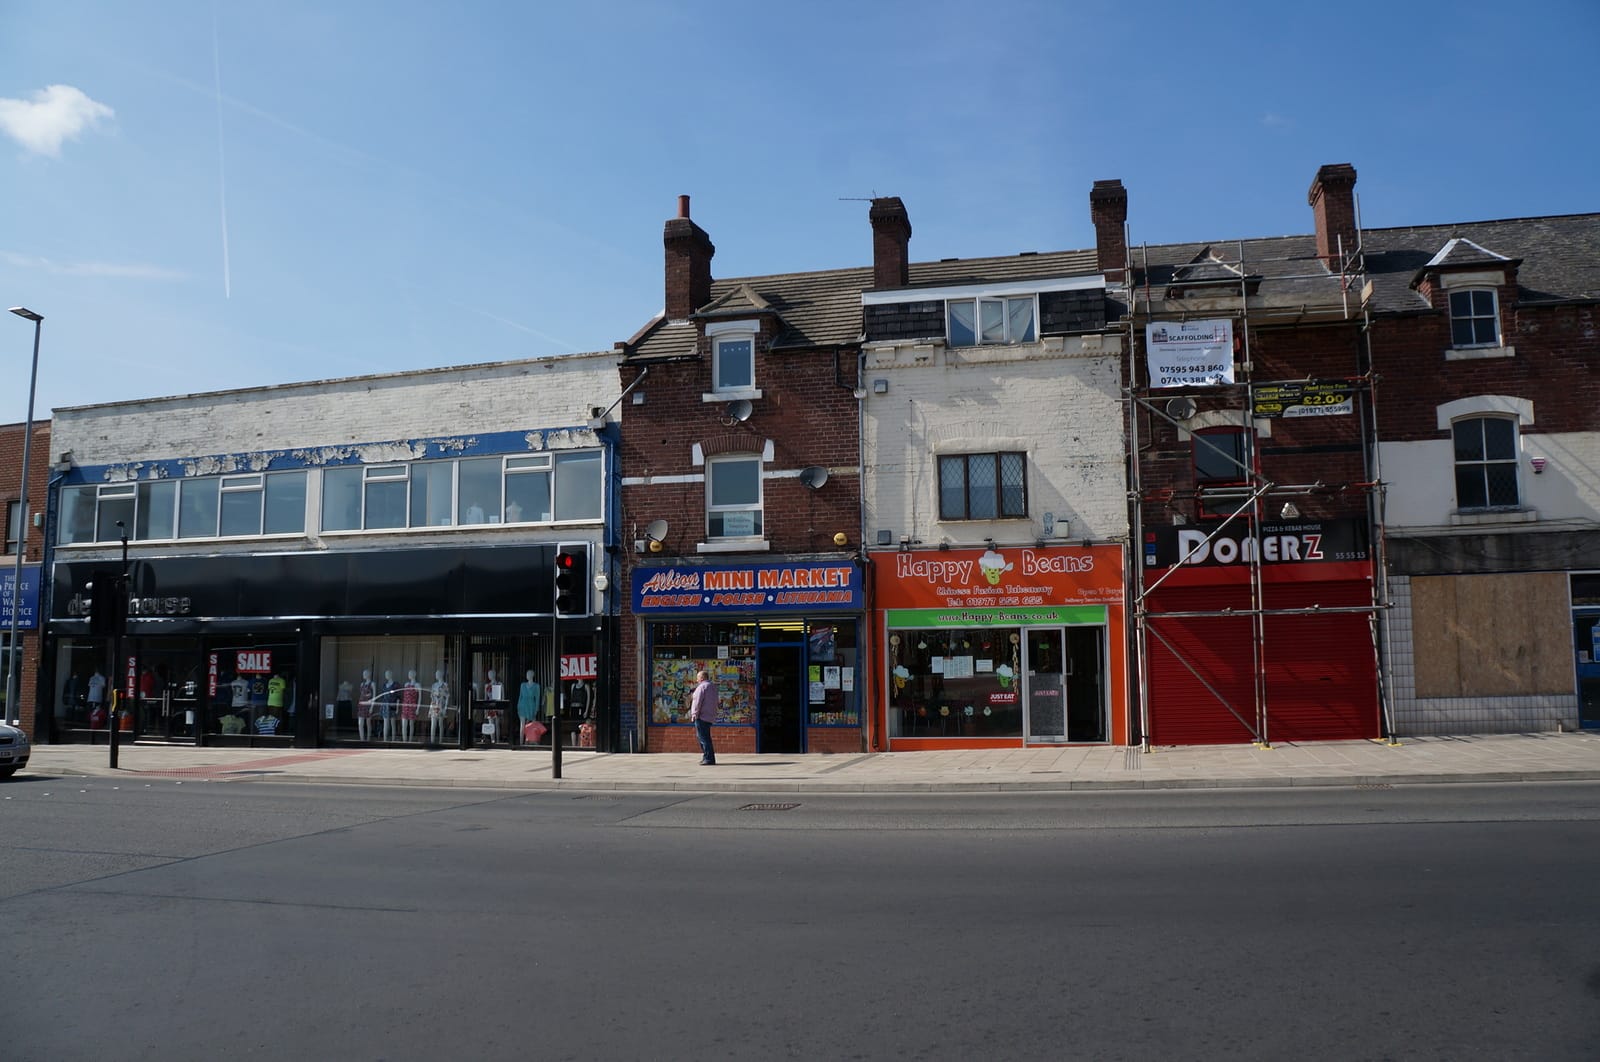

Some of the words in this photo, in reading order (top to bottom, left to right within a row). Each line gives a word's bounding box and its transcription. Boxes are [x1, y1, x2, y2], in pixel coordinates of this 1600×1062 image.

[1188, 365, 1206, 373] 943
[1207, 364, 1225, 372] 860
[1303, 394, 1345, 405] £2.00
[896, 553, 974, 584] Happy
[1022, 549, 1095, 576] Beans
[641, 569, 700, 594] Albion
[703, 570, 754, 590] MINI
[758, 567, 852, 590] MARKET
[641, 594, 702, 607] ENGLISH
[712, 592, 766, 606] POLISH
[775, 590, 853, 605] LITHUANIA
[936, 586, 971, 596] Chinese
[973, 585, 1004, 595] Fusion
[1005, 584, 1053, 596] Takeaway
[966, 597, 997, 606] 01977
[236, 653, 271, 671] SALE
[560, 656, 597, 677] SALE
[128, 657, 137, 698] SALE
[209, 654, 218, 696] SALE
